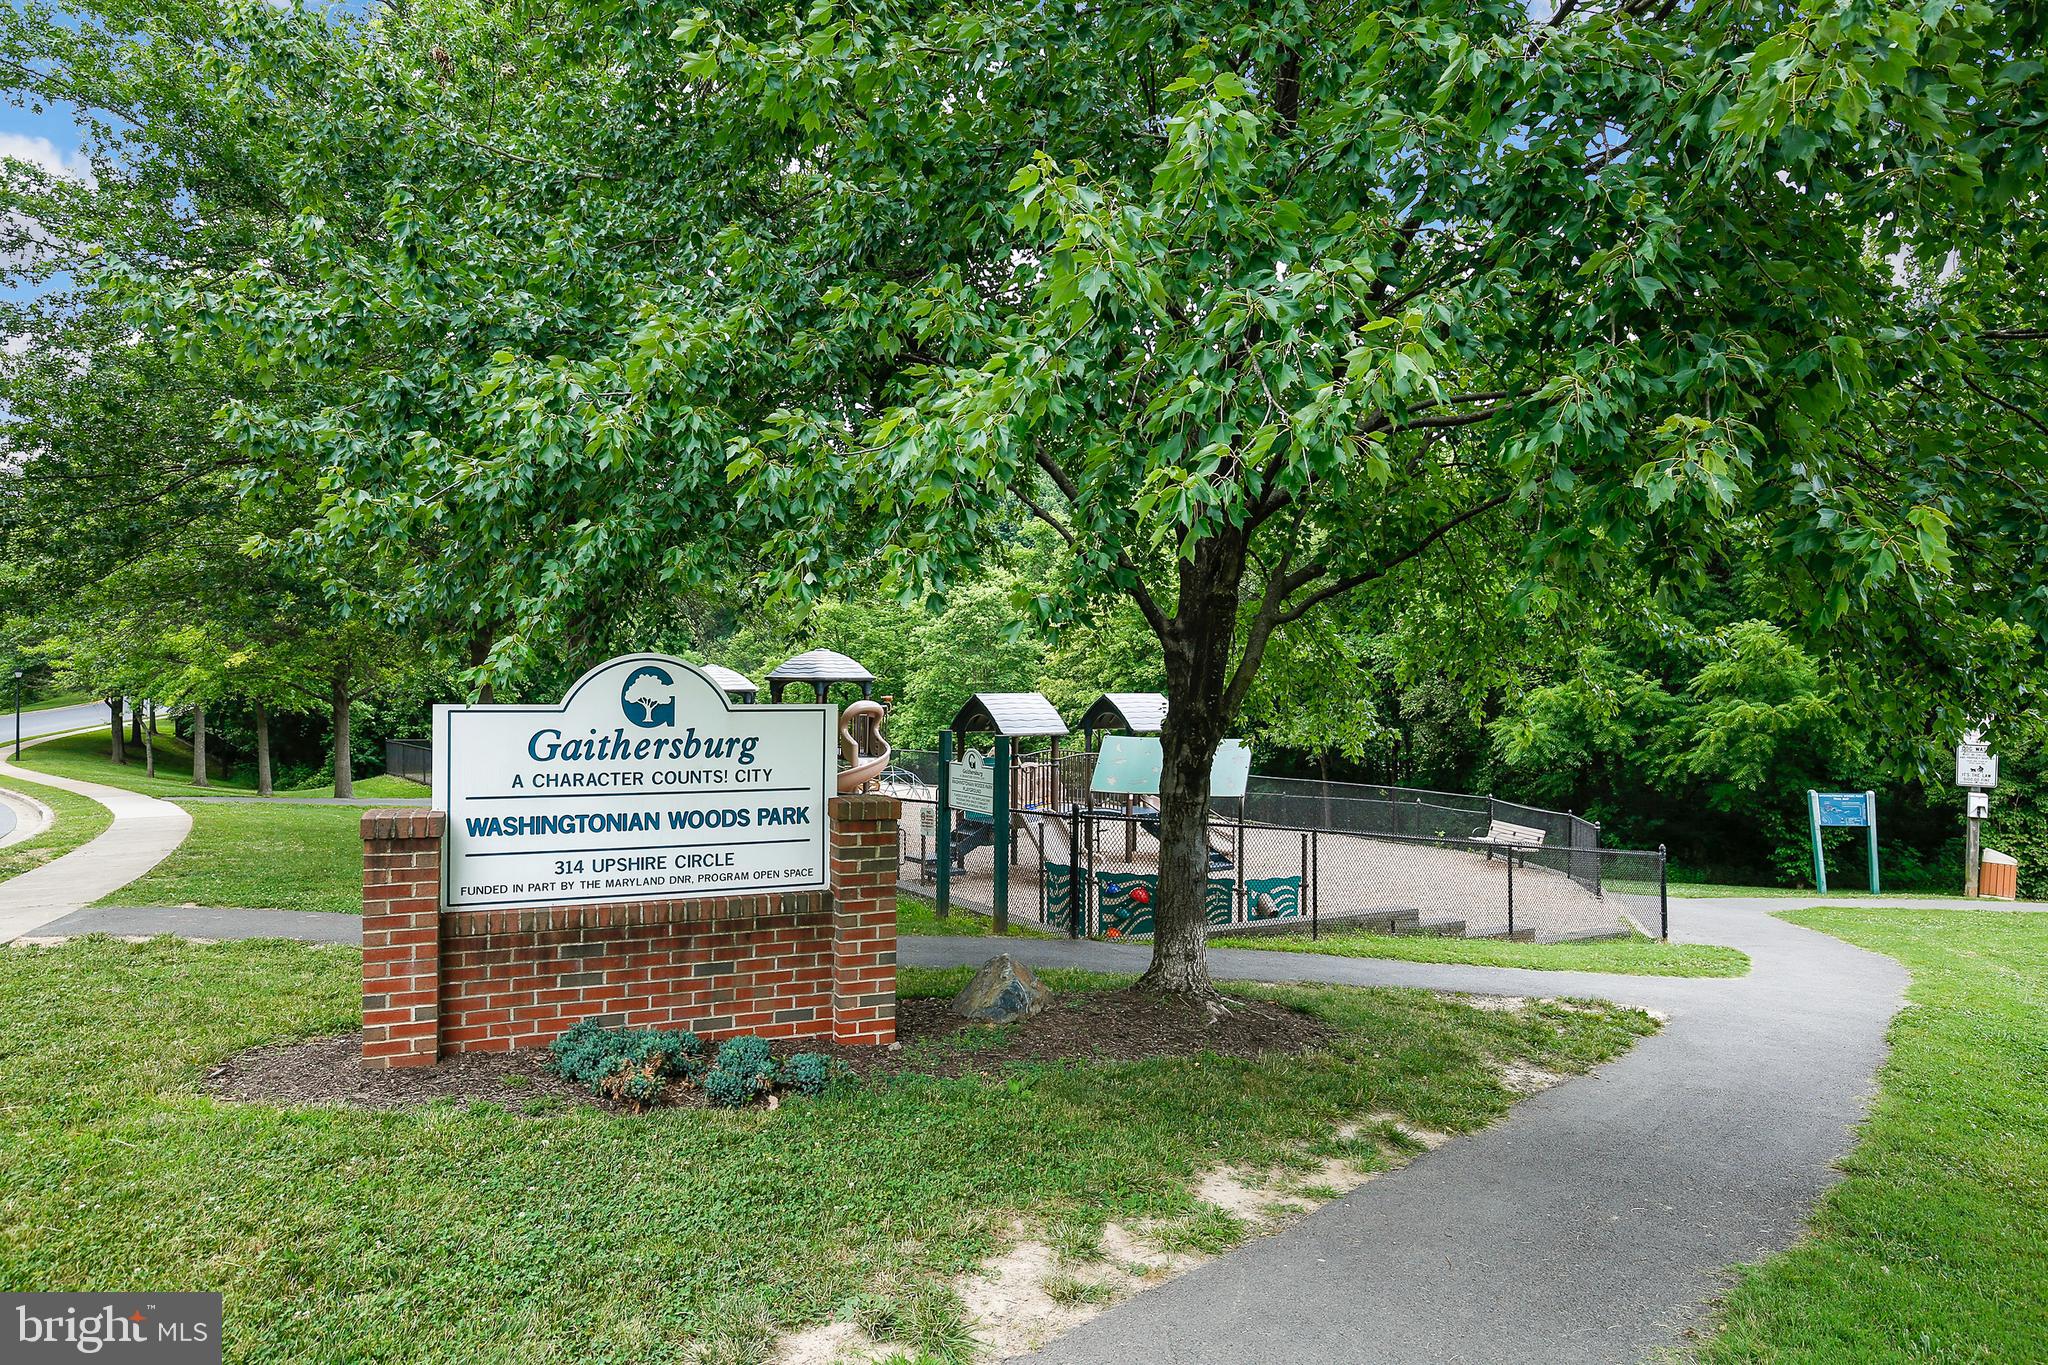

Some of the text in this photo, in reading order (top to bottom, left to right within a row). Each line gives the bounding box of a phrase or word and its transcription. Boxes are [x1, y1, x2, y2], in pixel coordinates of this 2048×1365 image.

[528, 727, 759, 765] Gaithersburg
[511, 768, 773, 789] A CHARACTER COUNTS! CITY
[465, 806, 810, 837] WASHINGTONIAN WOODS PARK
[554, 853, 735, 875] 314 UPSHIRE CIRCLE
[460, 868, 814, 896] FUNDED IN PART BY THE MARYLAND DNR, PROGRAM OPEN SPACE
